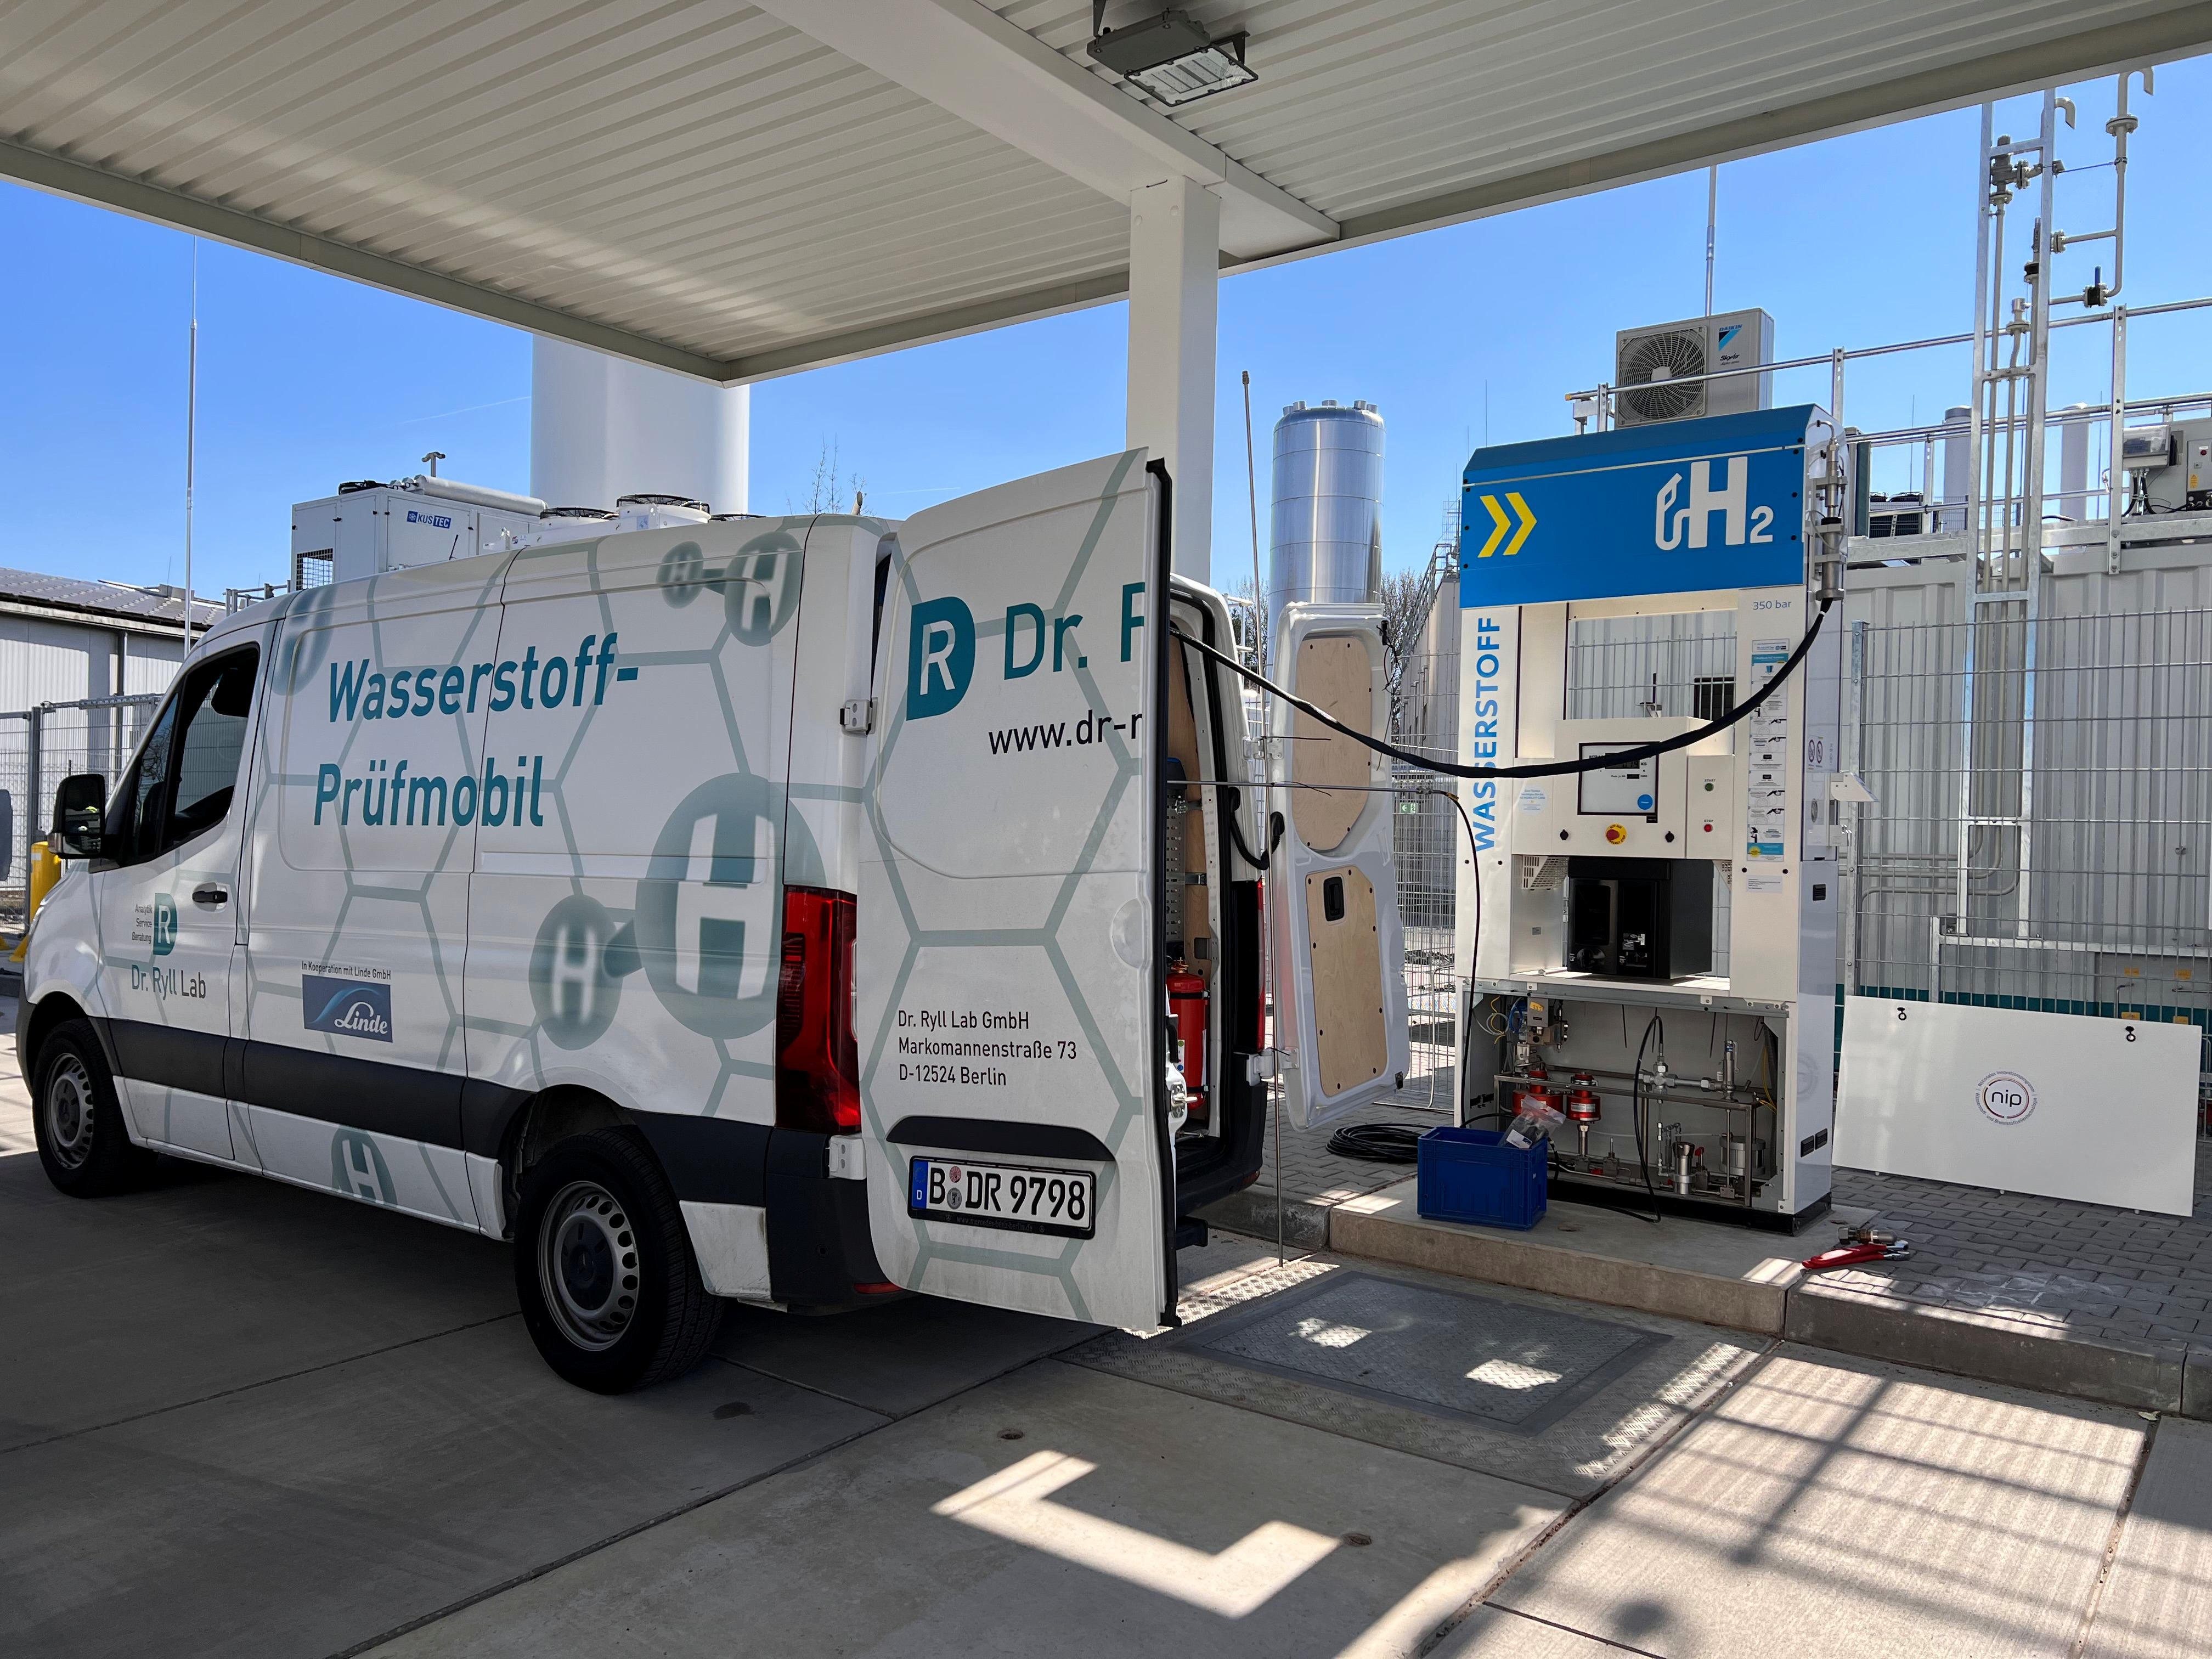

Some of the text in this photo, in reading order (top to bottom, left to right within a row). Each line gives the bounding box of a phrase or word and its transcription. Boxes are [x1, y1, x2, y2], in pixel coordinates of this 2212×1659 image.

[1753, 600, 1792, 610] 350 bar
[1004, 602, 1088, 680] Dr.
[330, 632, 639, 723] Wasserstoff-
[314, 755, 543, 827] Prüfmobil
[136, 918, 152, 928] Service
[132, 932, 152, 944] Beratung
[302, 961, 391, 980] In Kooperation mit Linde GmbH
[132, 964, 206, 1001] Dr. Ryll Lab
[334, 1002, 388, 1034] Linde
[899, 1010, 1029, 1031] Dr. Ryll Lab GmbH
[899, 1037, 1076, 1059] Markomannenstraße 73
[900, 1064, 1006, 1085] D-12524 Berlin
[1992, 1090, 2022, 1107] nip
[917, 1190, 922, 1200] D
[929, 1167, 1085, 1220] B DR 9798
